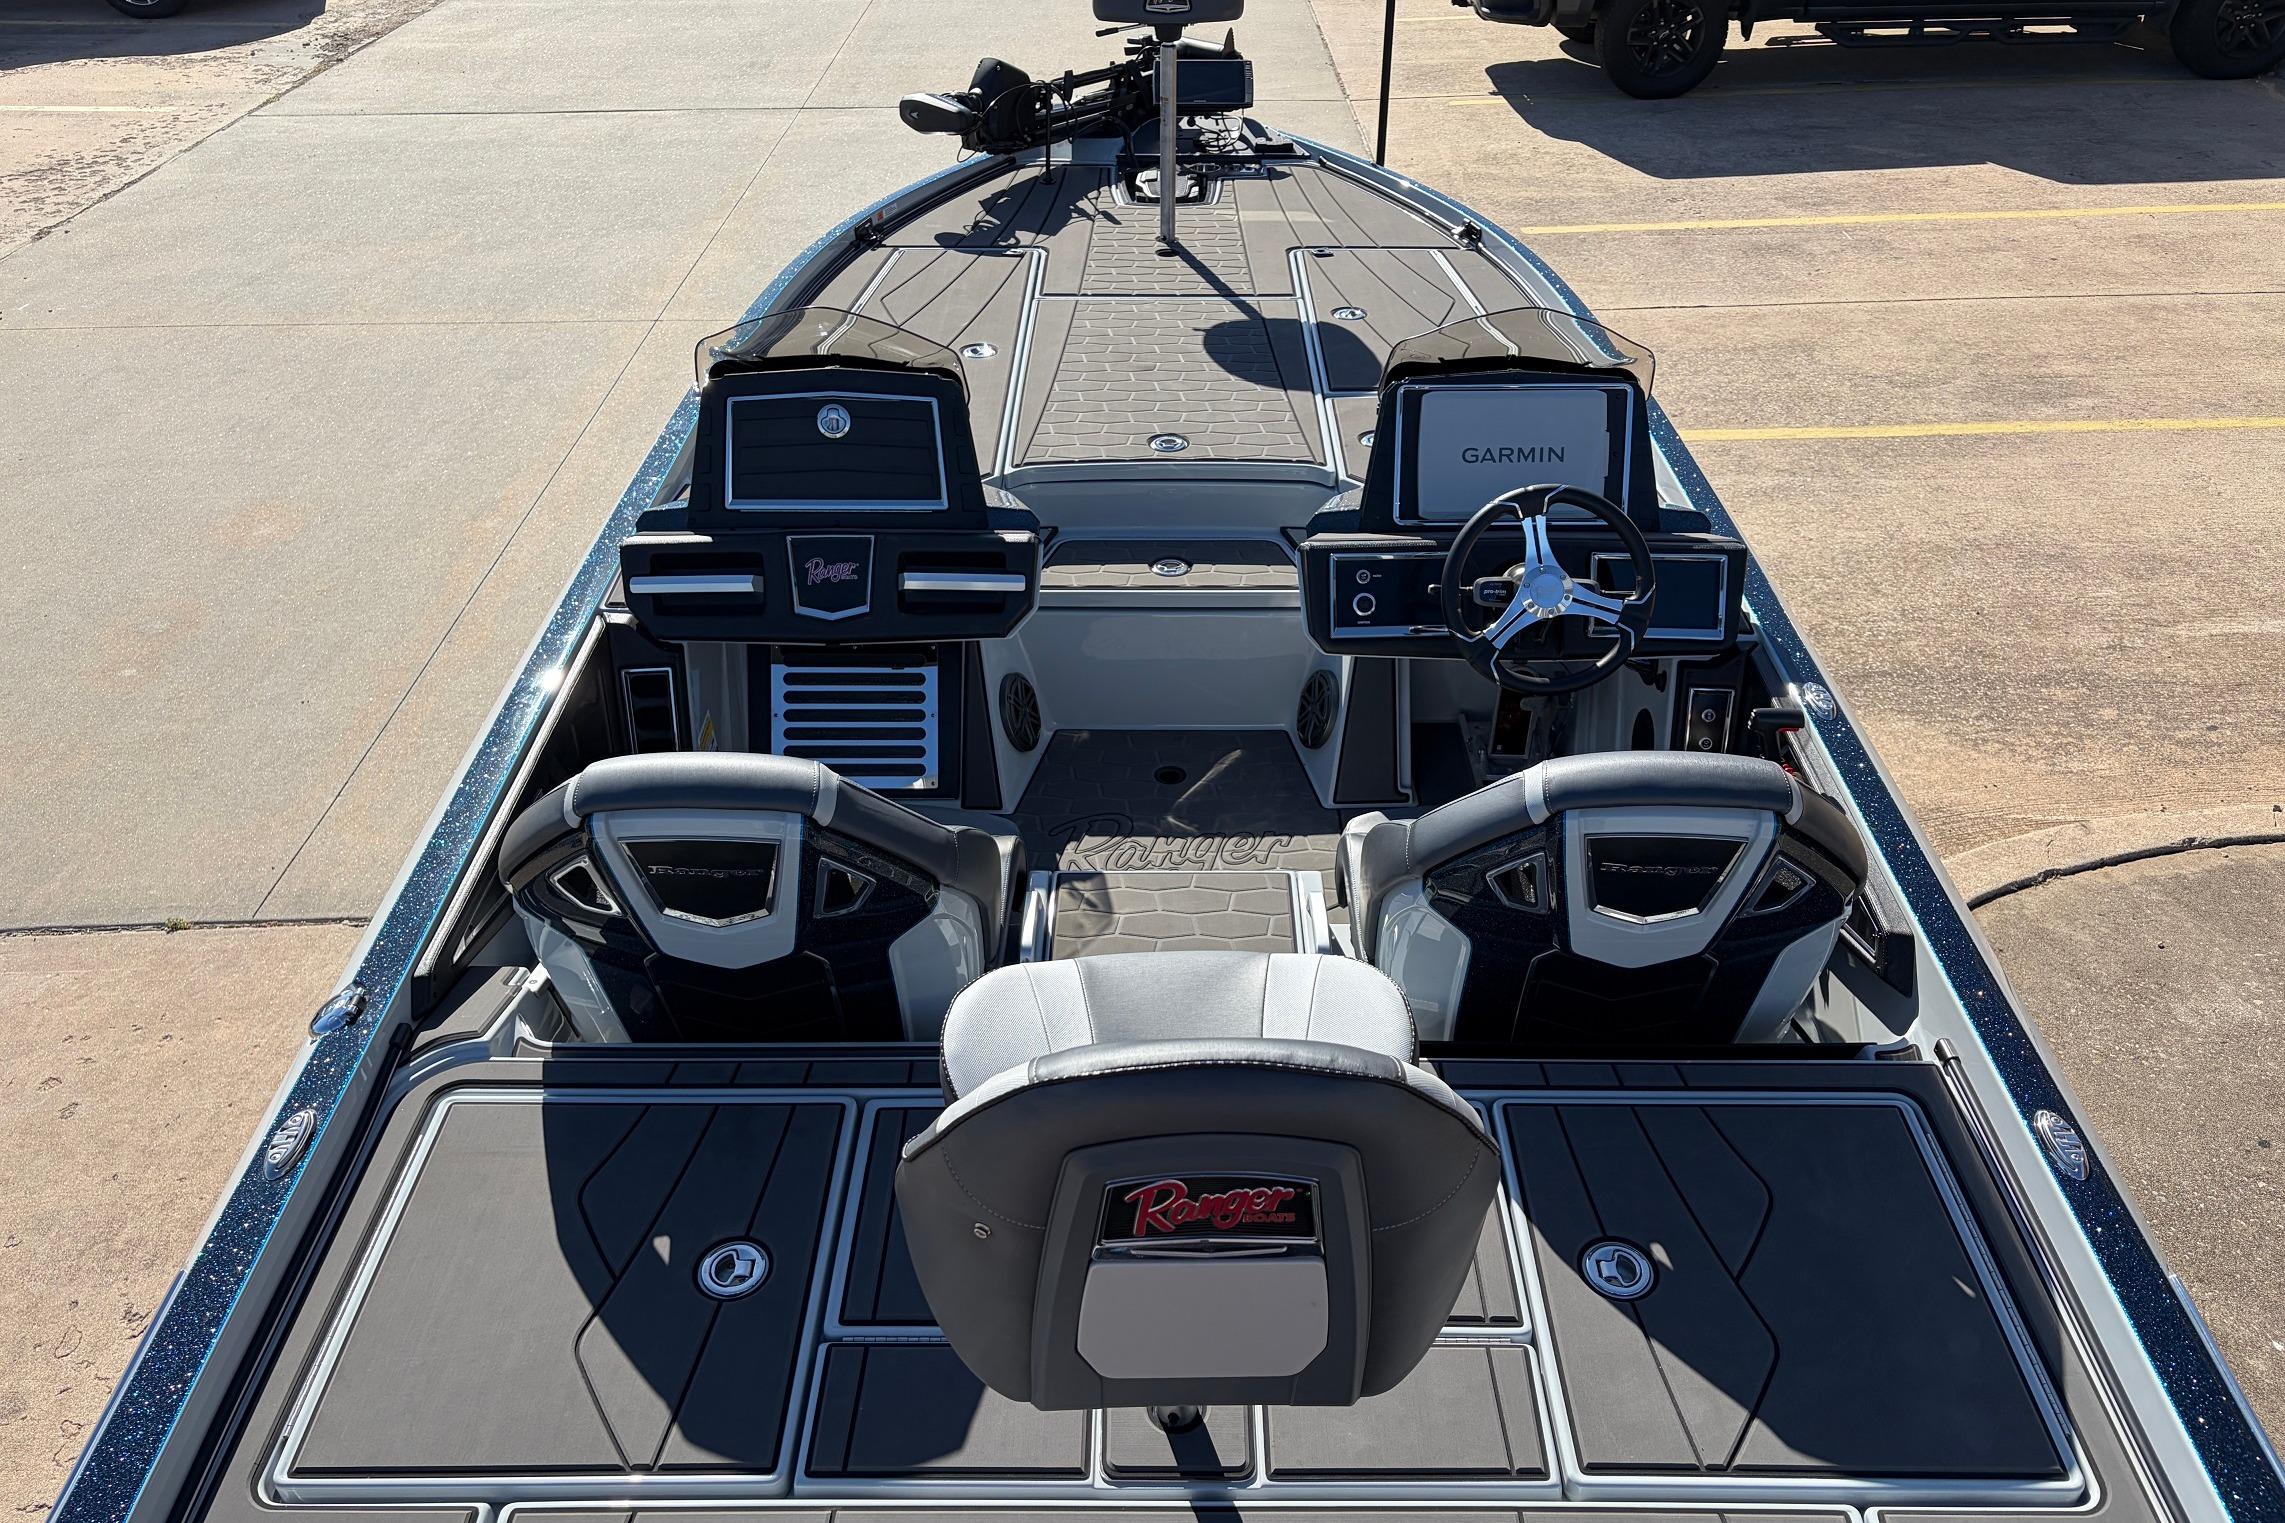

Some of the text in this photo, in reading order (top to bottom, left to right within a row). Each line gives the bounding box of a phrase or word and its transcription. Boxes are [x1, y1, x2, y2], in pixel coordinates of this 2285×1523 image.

[1461, 446, 1565, 464] GARMIN
[805, 557, 856, 585] Ranger
[1049, 813, 1293, 871] Ranger
[647, 865, 764, 878] Ranger
[1124, 1179, 1295, 1237] Ranger
[1243, 1212, 1296, 1224] BOATS
